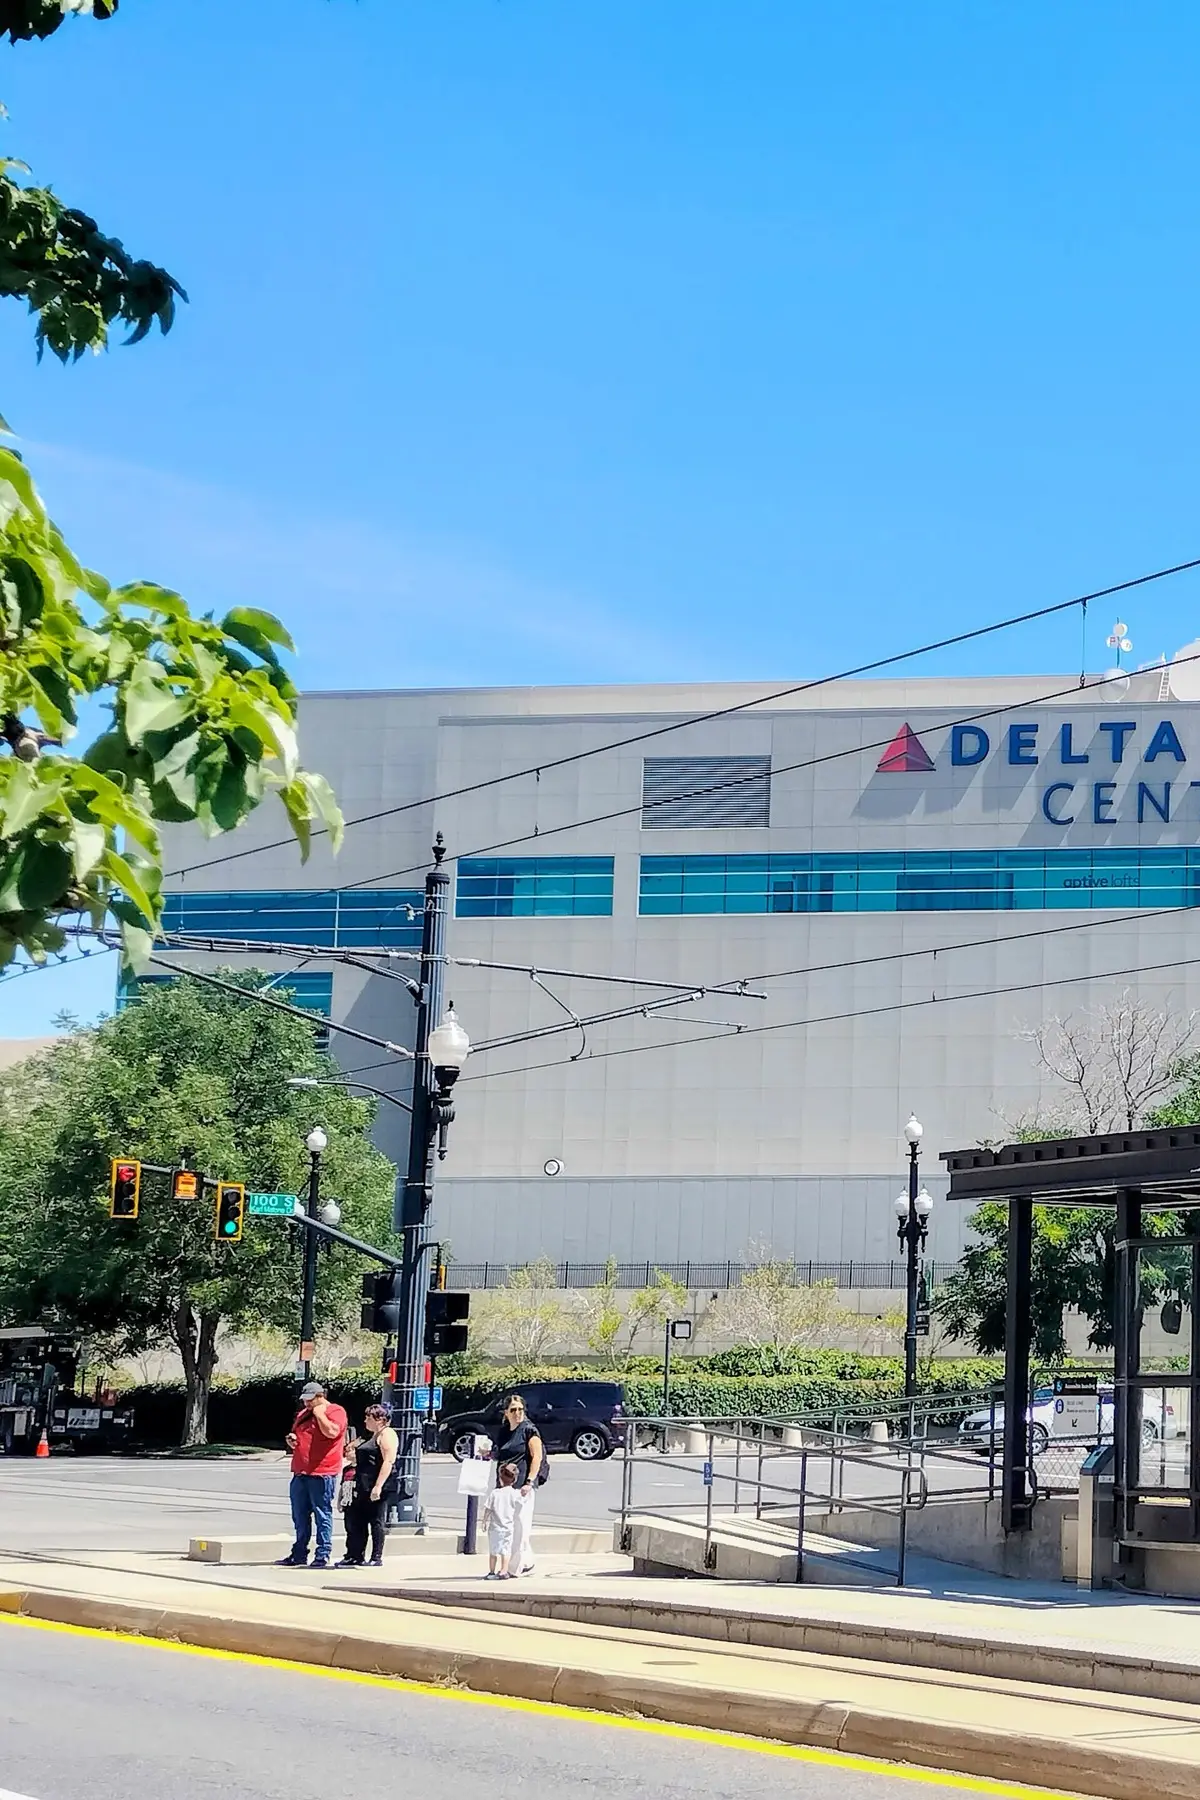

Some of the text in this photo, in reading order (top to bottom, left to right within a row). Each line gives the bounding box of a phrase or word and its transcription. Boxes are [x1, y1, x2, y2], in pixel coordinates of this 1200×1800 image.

[952, 721, 1186, 766] DELTA
[254, 1195, 293, 1207] 100 S
